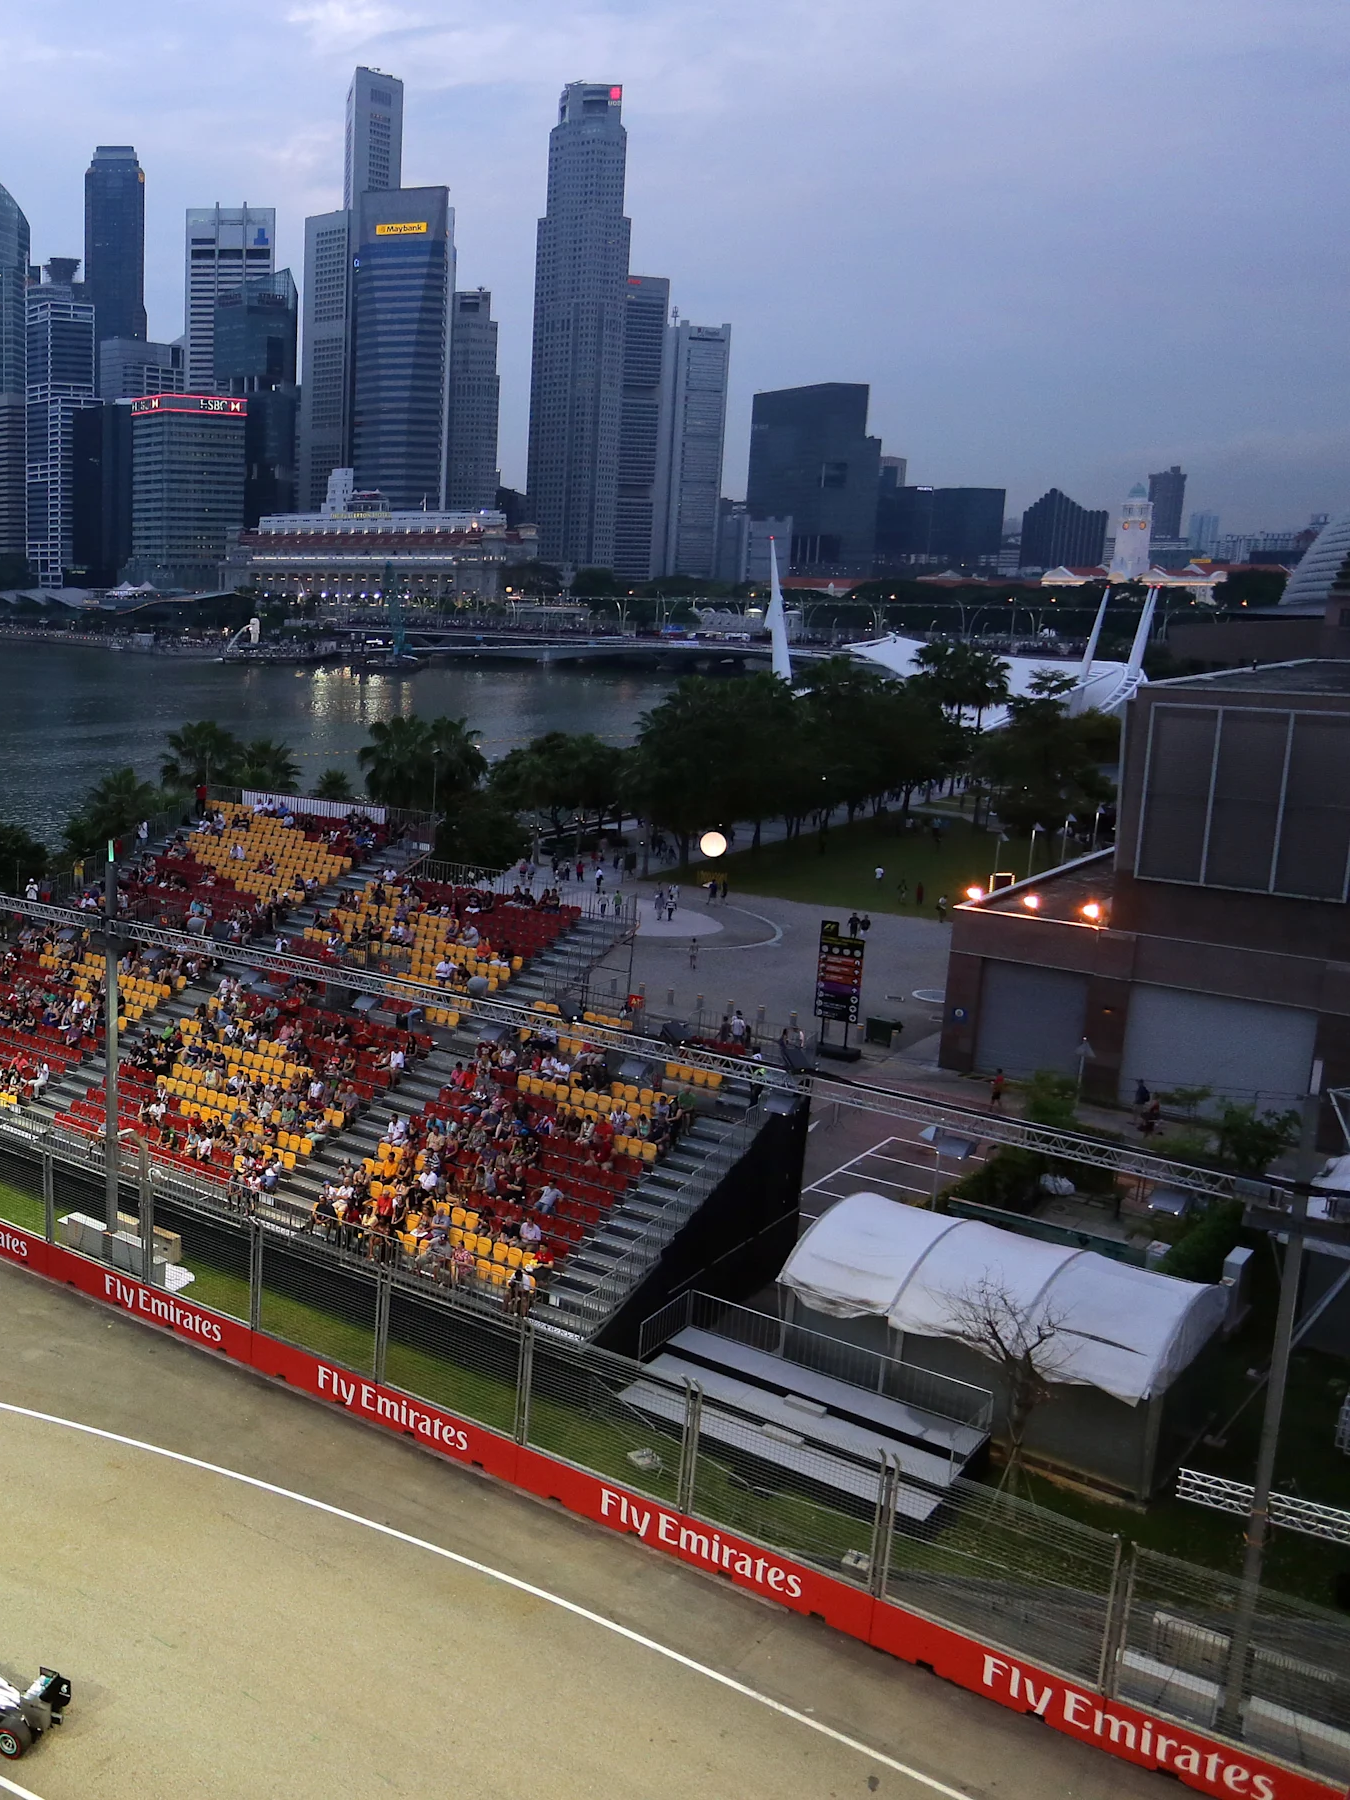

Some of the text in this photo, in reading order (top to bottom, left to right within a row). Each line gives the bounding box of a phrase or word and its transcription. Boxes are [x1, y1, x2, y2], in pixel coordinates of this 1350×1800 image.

[386, 224, 422, 234] Maybank
[104, 1273, 222, 1342] Fly Emirates
[317, 1365, 468, 1451] Fly Emirates
[600, 1488, 803, 1598] Fly Emirates
[983, 1654, 1275, 1800] Fly Emirates
